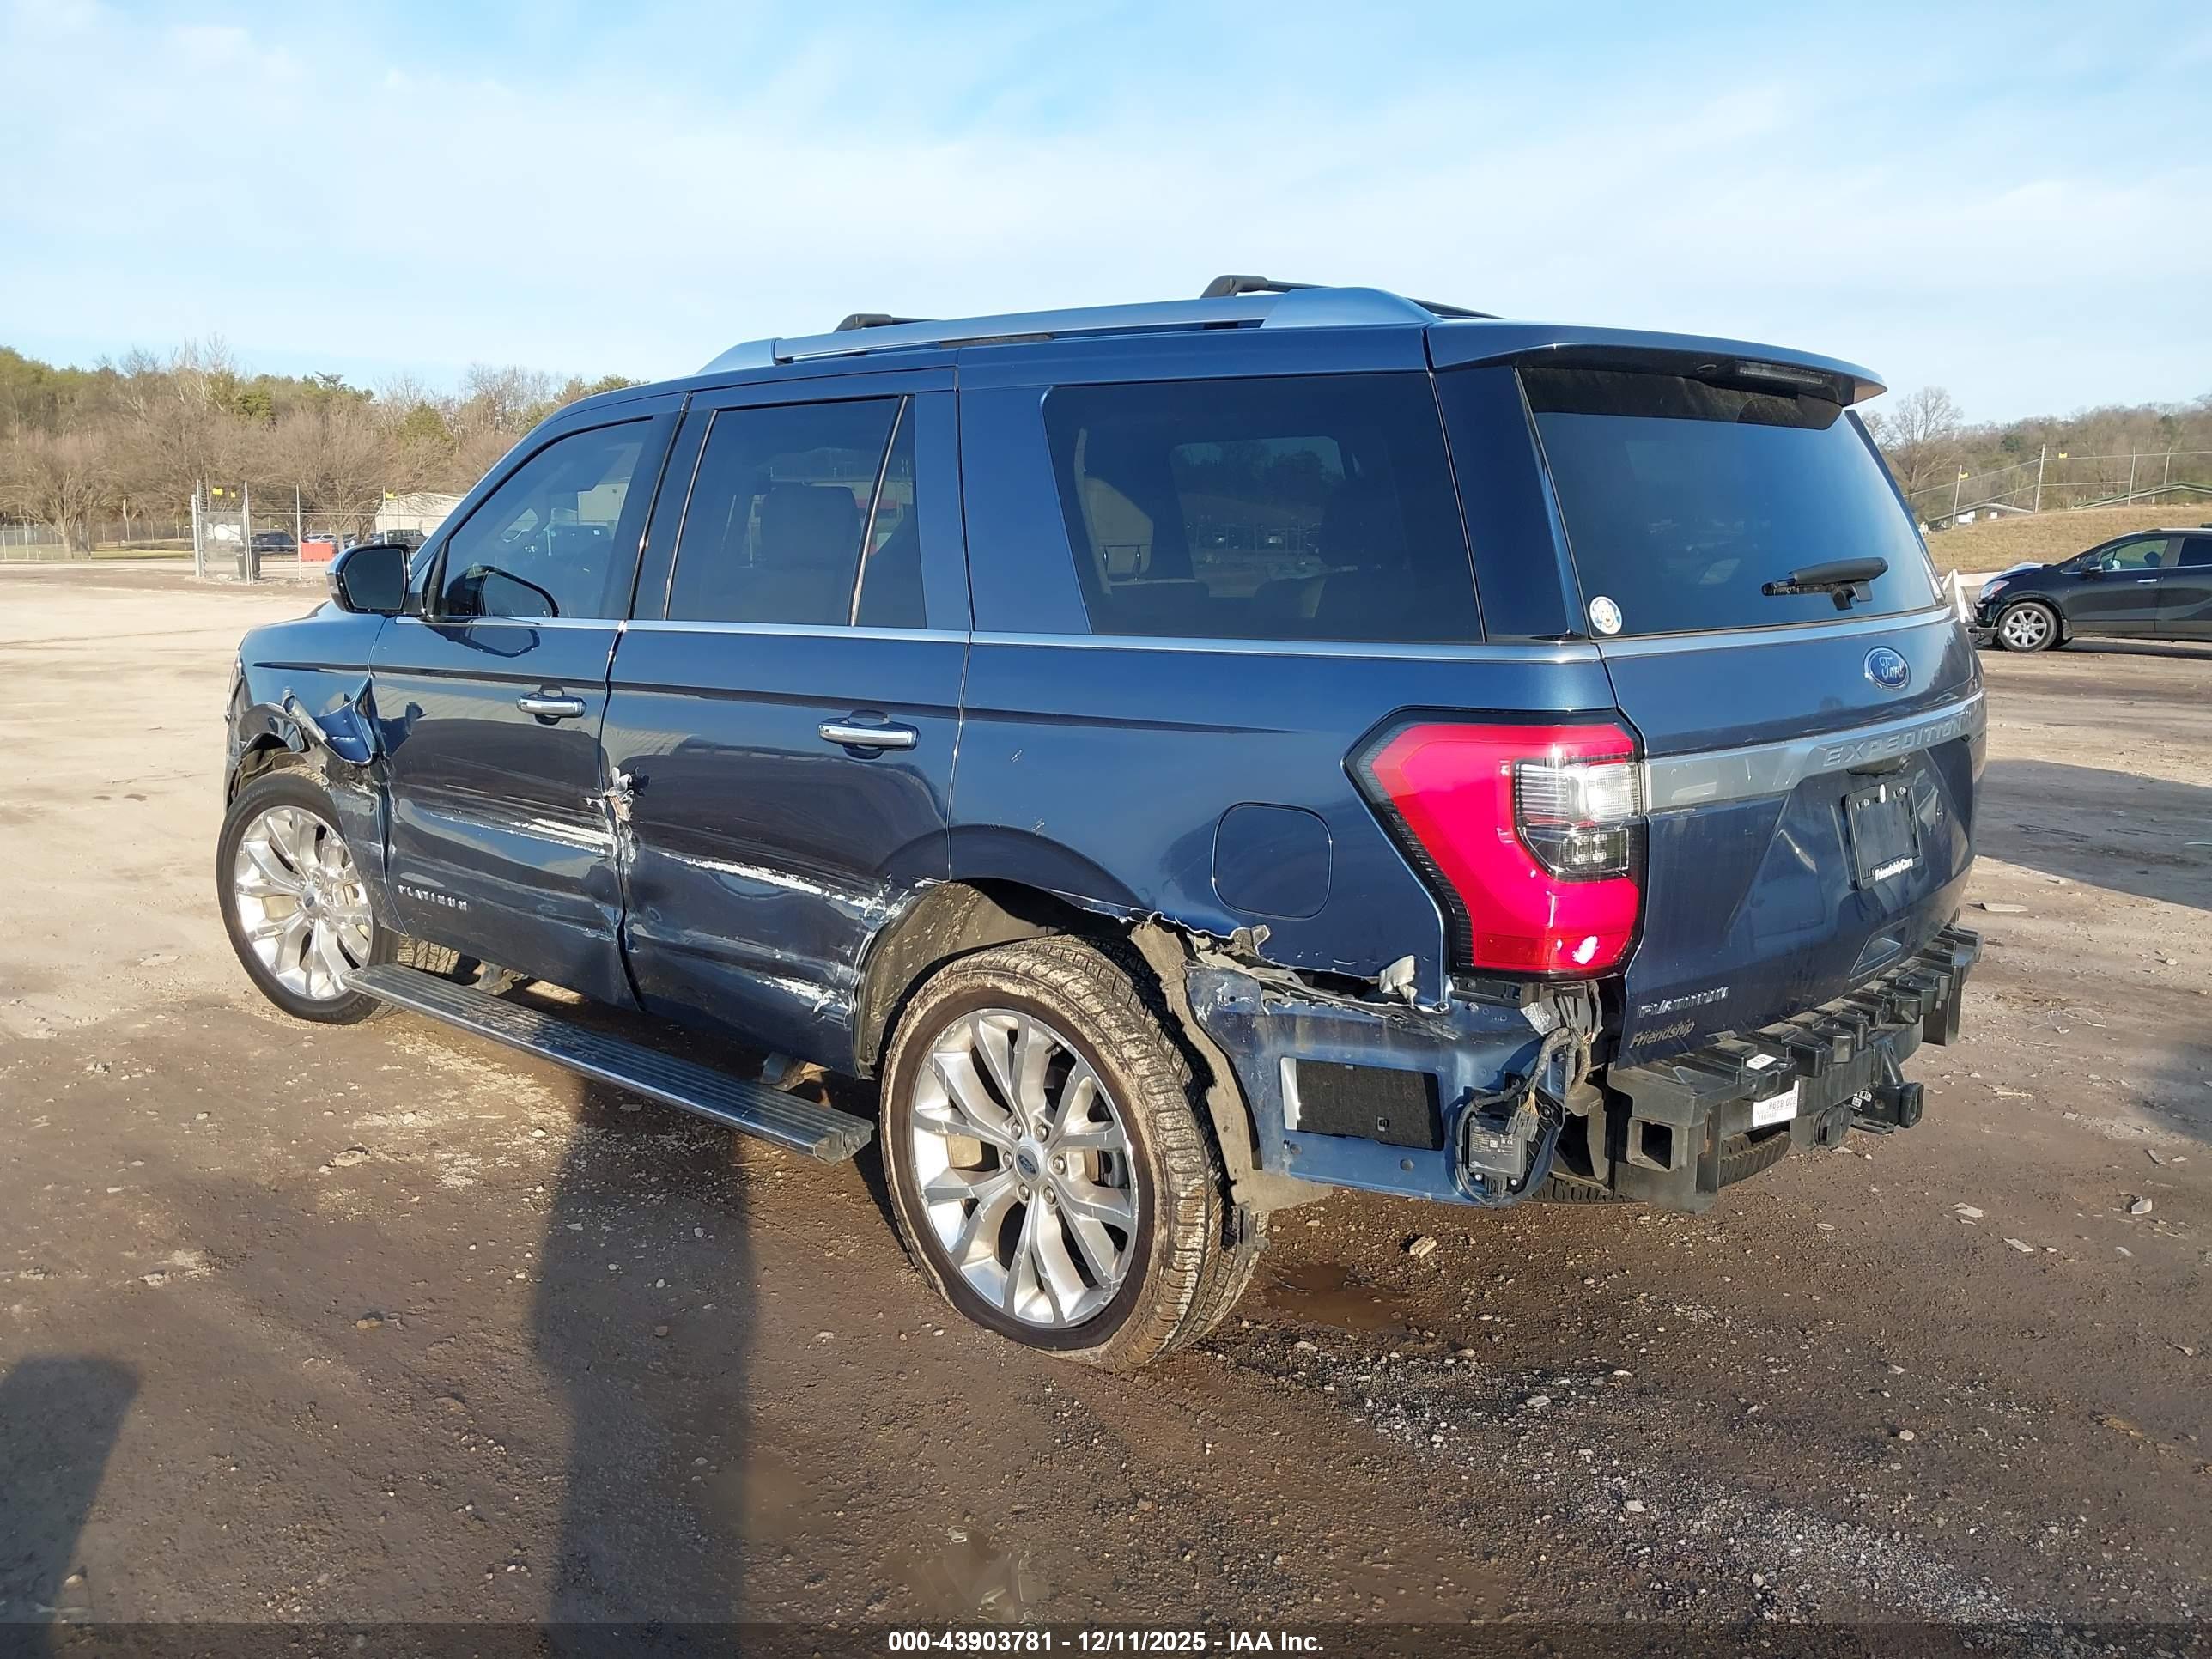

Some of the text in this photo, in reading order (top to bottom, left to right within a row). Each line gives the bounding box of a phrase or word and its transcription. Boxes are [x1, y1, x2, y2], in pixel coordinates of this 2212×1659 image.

[1878, 656, 1905, 678] Ford
[1825, 718, 1961, 765] EXPEDITION
[398, 884, 467, 912] PLATINUM
[1628, 1018, 1696, 1048] Friendship
